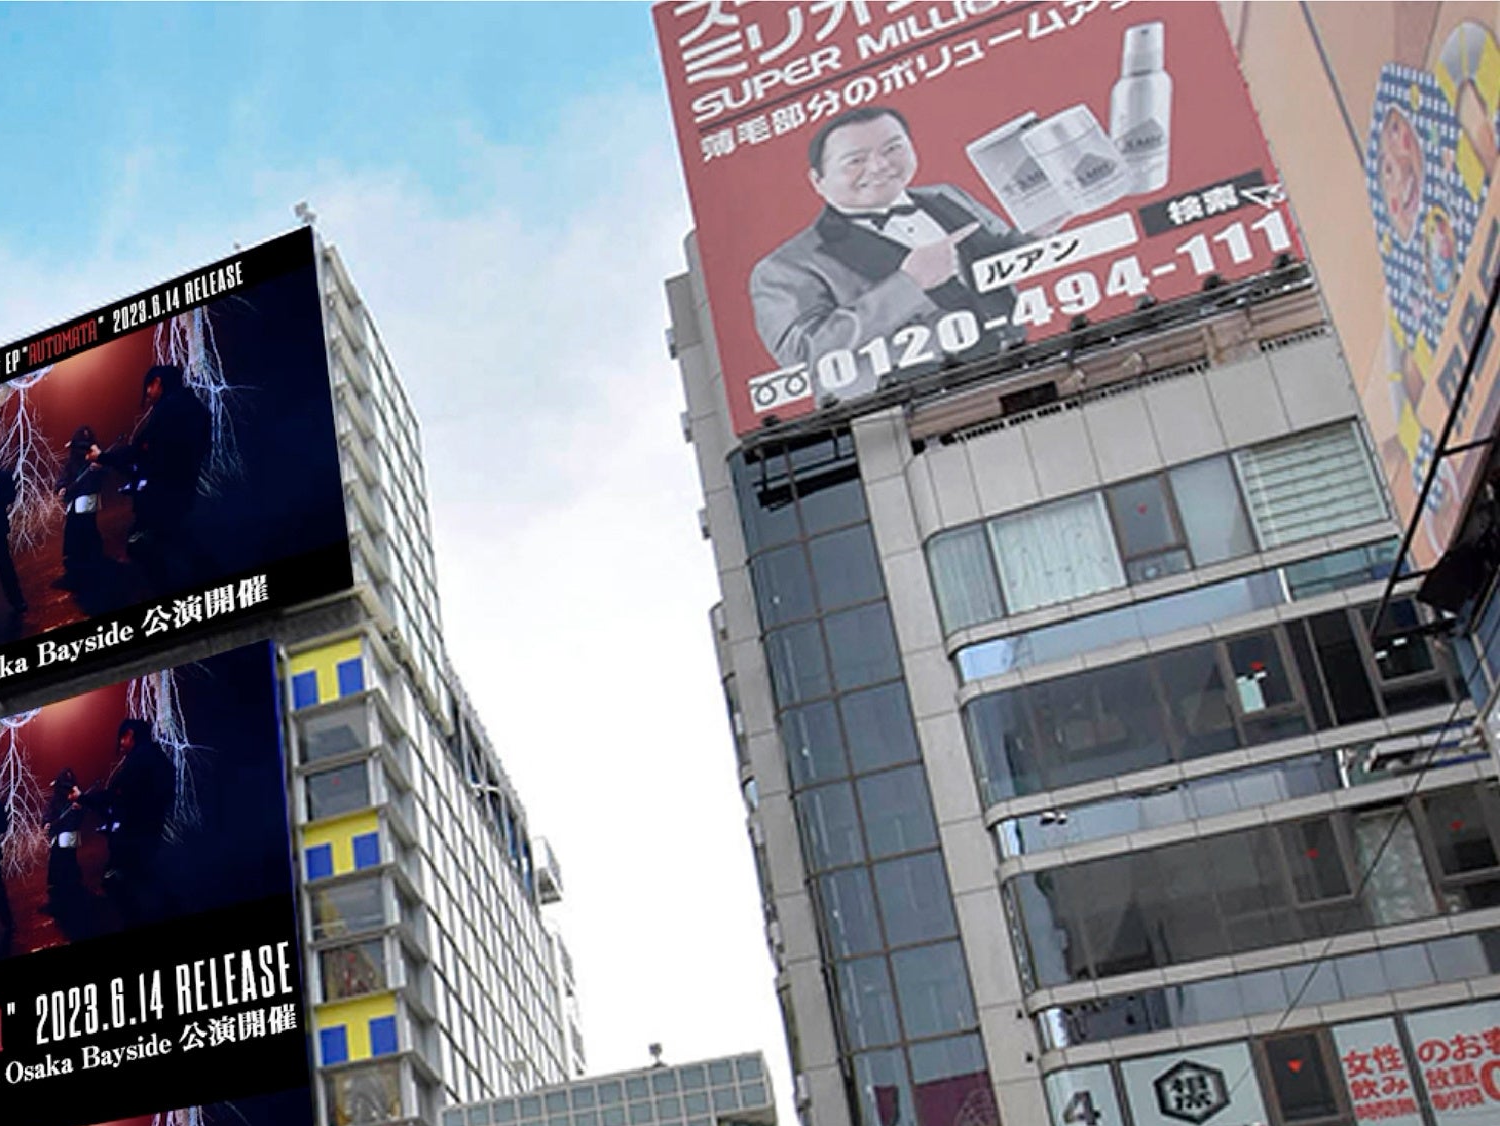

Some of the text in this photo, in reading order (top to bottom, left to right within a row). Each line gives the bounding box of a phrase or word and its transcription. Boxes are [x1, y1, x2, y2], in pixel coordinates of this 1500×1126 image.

[691, 46, 842, 123] SUPER
[1166, 187, 1240, 227] 検索
[817, 211, 1296, 391] 0120-494-111
[984, 235, 1082, 284] ルアン
[5, 349, 21, 375] EP
[112, 290, 181, 334] 2023.6.14
[184, 261, 244, 305] RELEASE
[36, 624, 135, 671] Bayside
[141, 574, 269, 638] 公演開催
[35, 969, 164, 1045] 2023.6.14
[175, 941, 294, 1014] RELEASE
[5, 1053, 74, 1087] Osaka
[81, 1035, 173, 1076] Bayside
[179, 1003, 298, 1053] 公演開催
